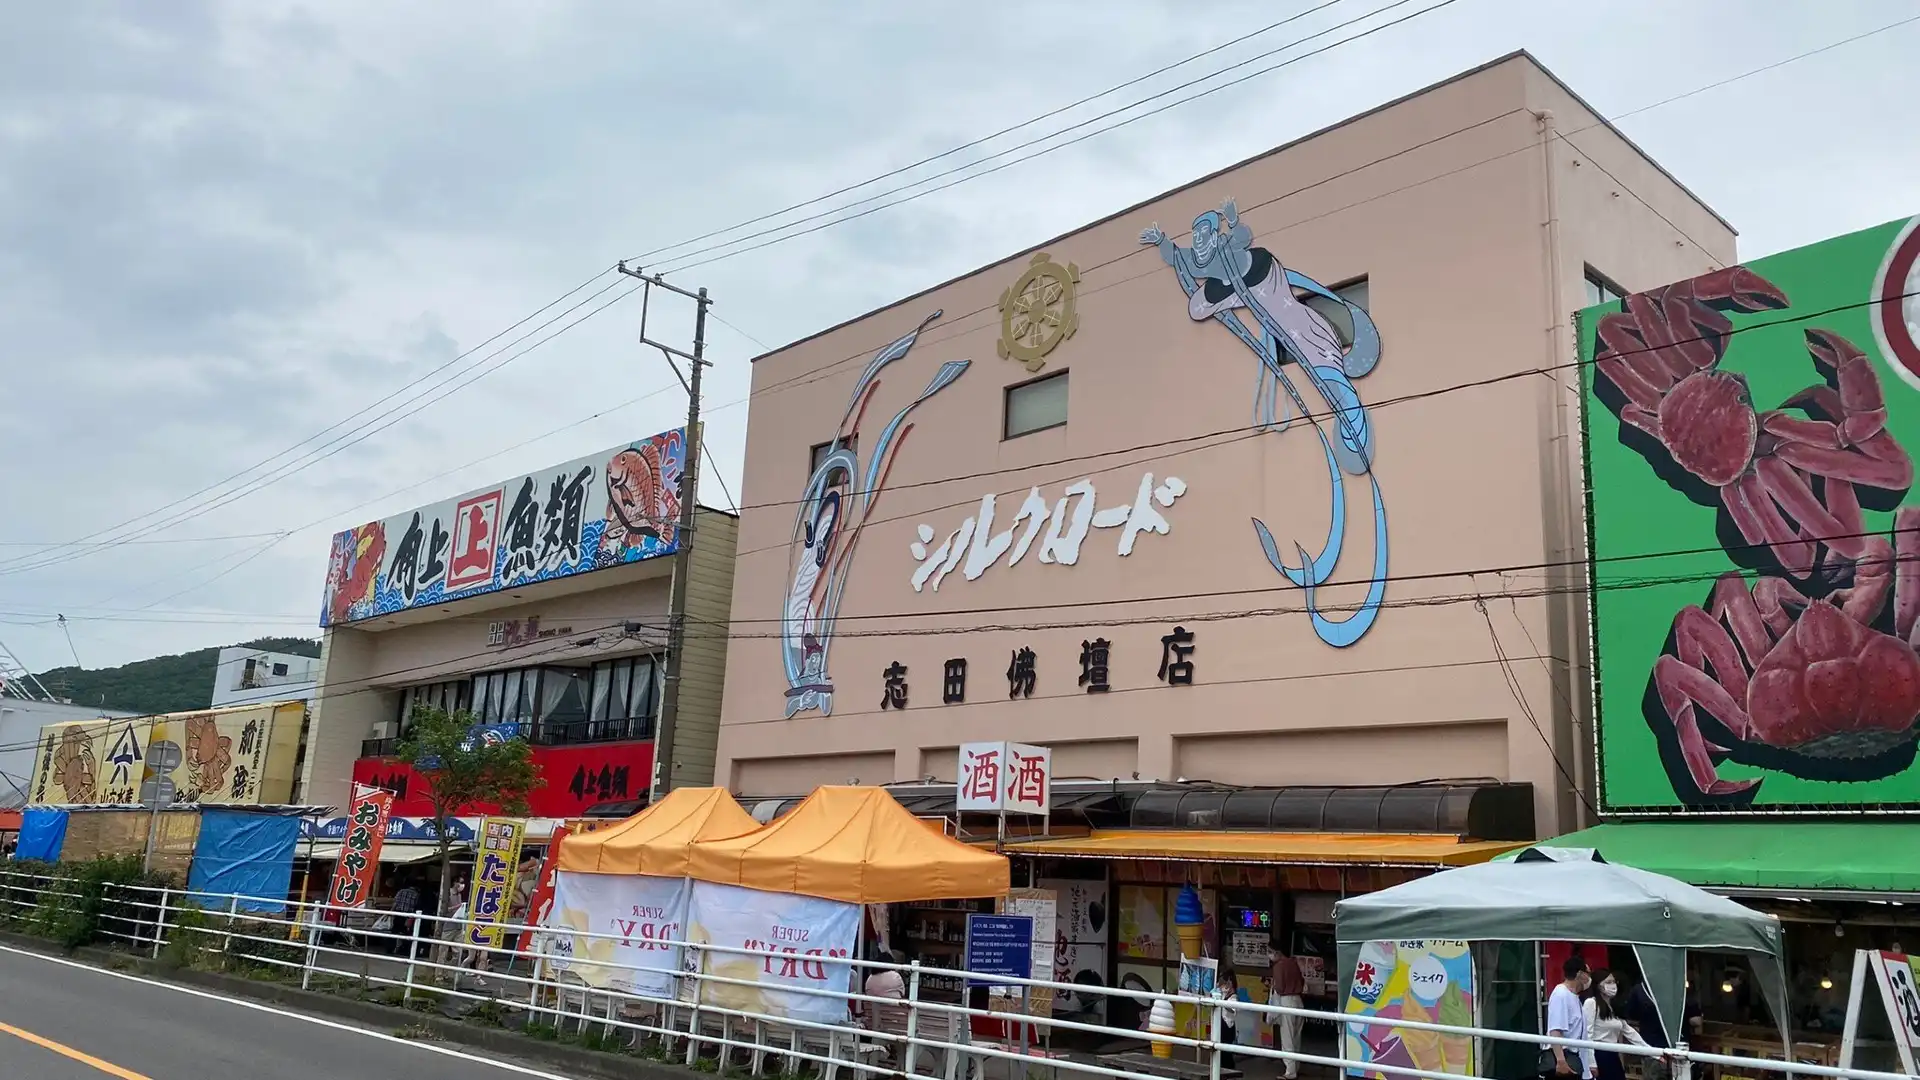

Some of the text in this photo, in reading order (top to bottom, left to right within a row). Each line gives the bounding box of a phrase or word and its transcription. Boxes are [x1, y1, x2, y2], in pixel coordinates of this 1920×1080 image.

[501, 465, 592, 580] 魚類
[910, 472, 1188, 592] シルクロード
[880, 626, 1196, 710] 志田佛壇店
[962, 749, 999, 803] 酒
[1007, 750, 1046, 808] 酒
[336, 801, 381, 905] おみやげ
[470, 851, 508, 945] たばこ
[1355, 961, 1376, 986] 氷
[1412, 971, 1444, 984] シェイク
